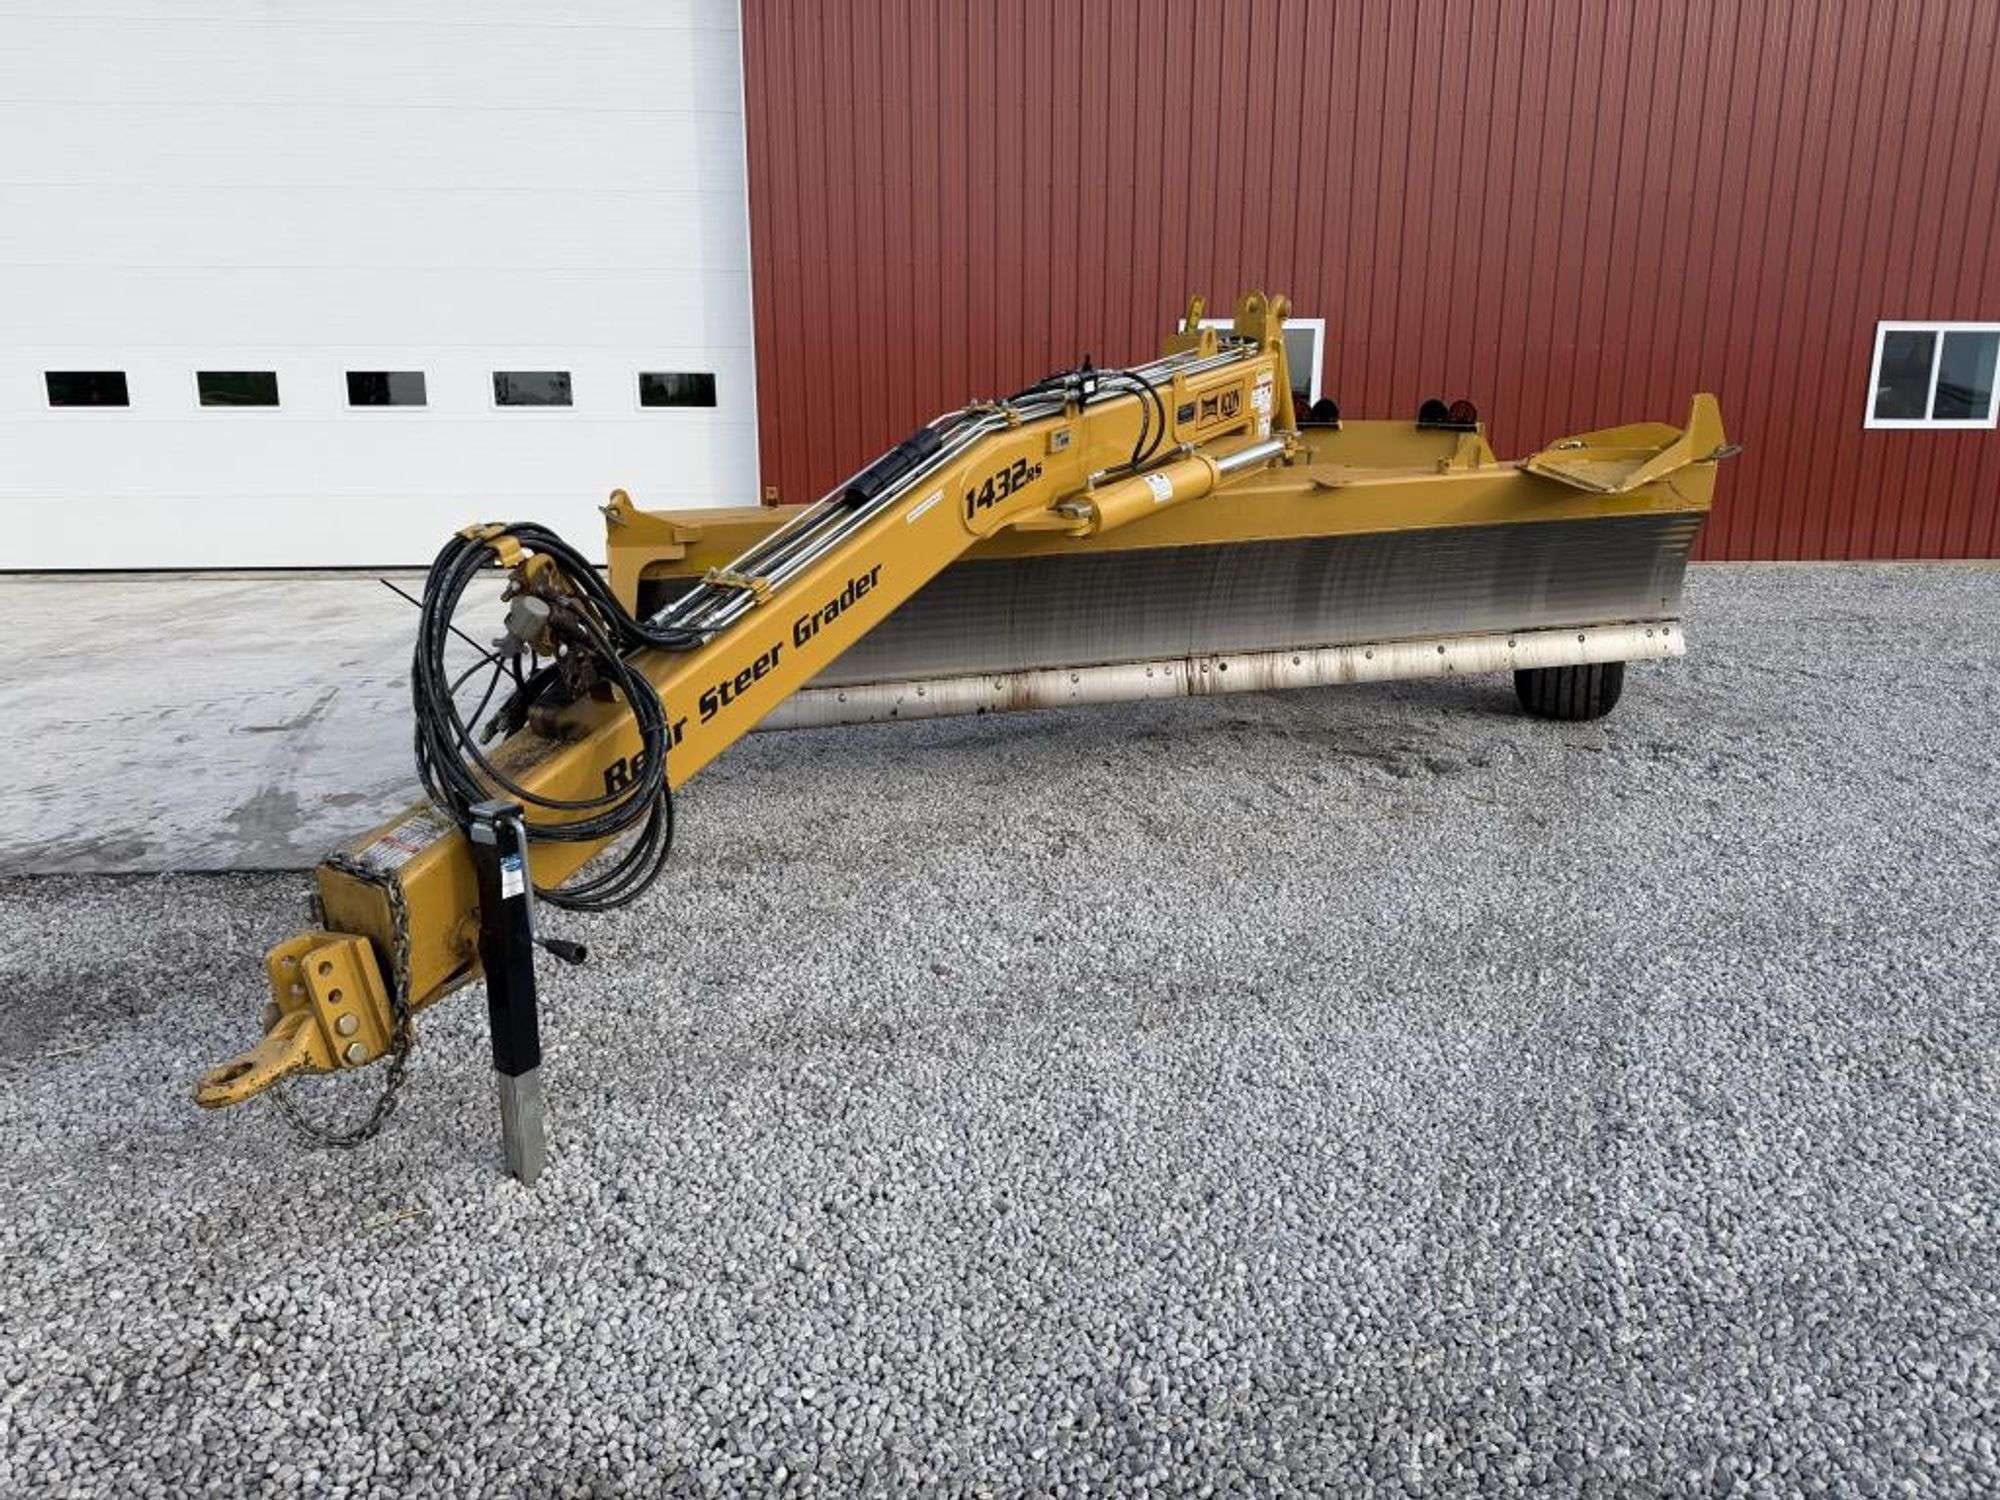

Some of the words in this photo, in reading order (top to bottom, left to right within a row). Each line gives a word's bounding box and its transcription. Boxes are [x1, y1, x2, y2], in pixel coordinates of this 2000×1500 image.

[604, 715, 688, 797] Rer
[699, 641, 785, 725] Steer
[793, 564, 882, 650] Grader
